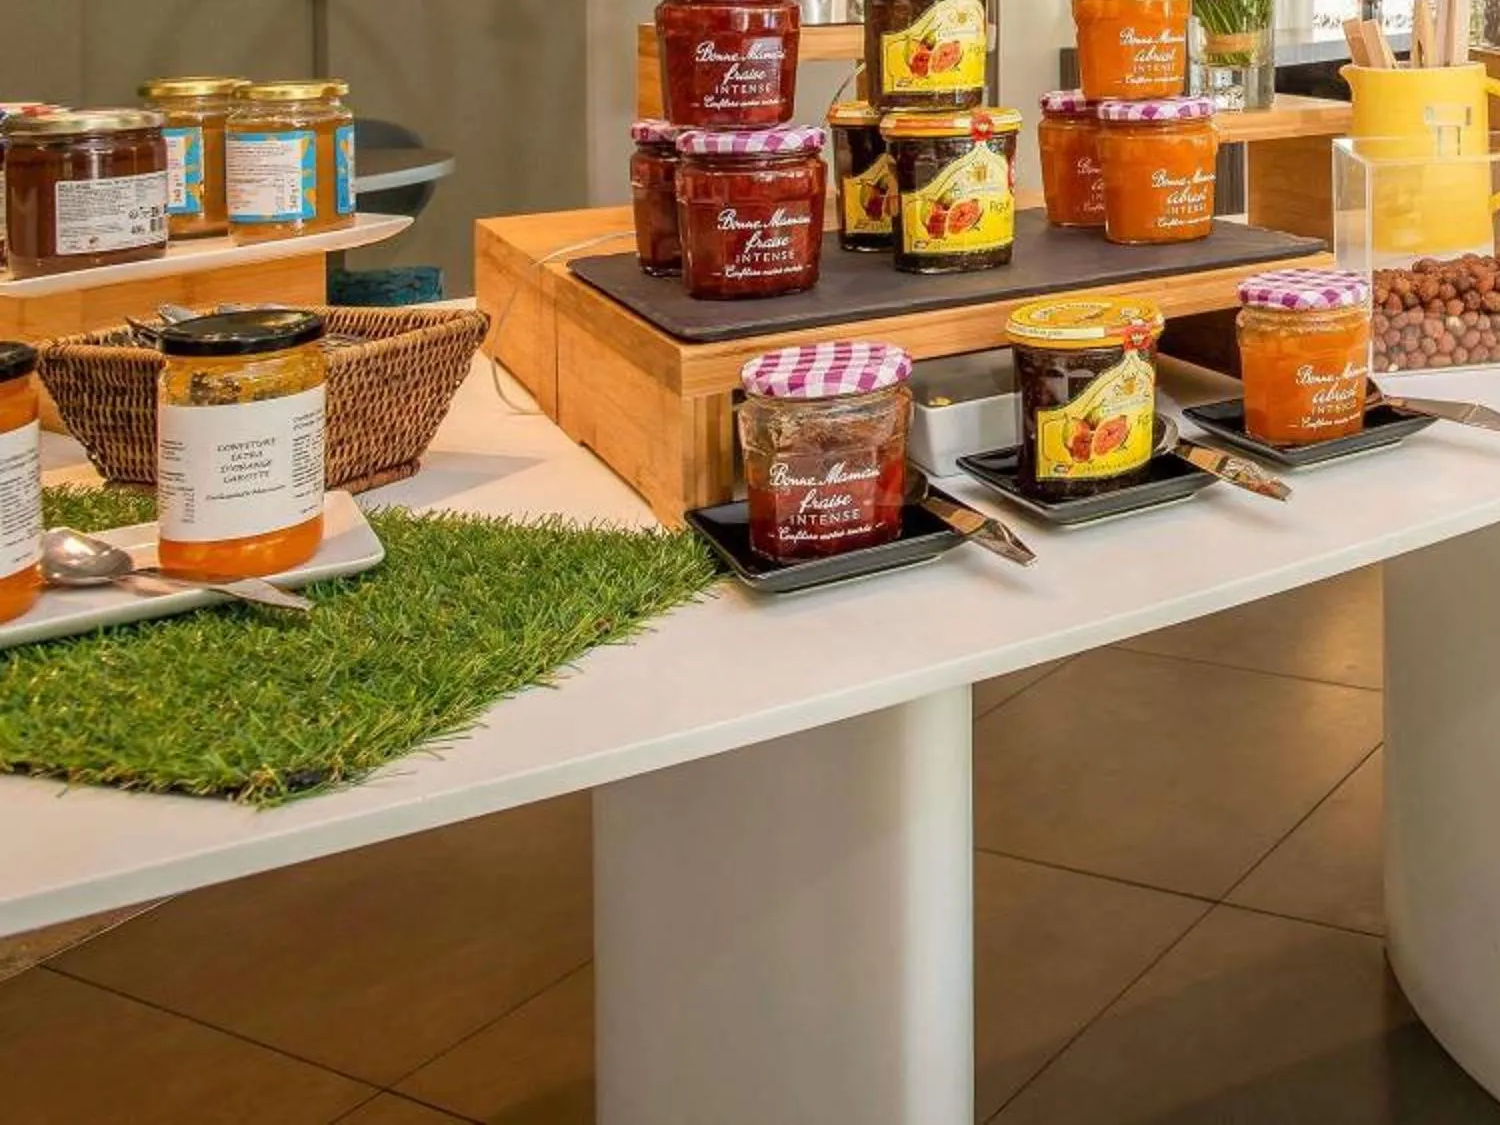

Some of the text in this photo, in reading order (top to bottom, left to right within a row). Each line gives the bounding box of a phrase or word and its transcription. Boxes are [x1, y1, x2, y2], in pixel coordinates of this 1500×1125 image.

[1119, 27, 1156, 46] Bonne
[695, 40, 740, 62] Bonne
[721, 61, 768, 86] fraise
[715, 84, 773, 94] INTENSE
[1152, 168, 1187, 188] Bonne
[717, 208, 762, 230] Bonne
[744, 230, 790, 254] fraise
[735, 251, 795, 263] INTENSE
[1296, 364, 1336, 385] Bonne
[769, 461, 880, 486] Bonne Maman
[799, 488, 852, 514] fraise
[789, 508, 861, 525] INTENSE
